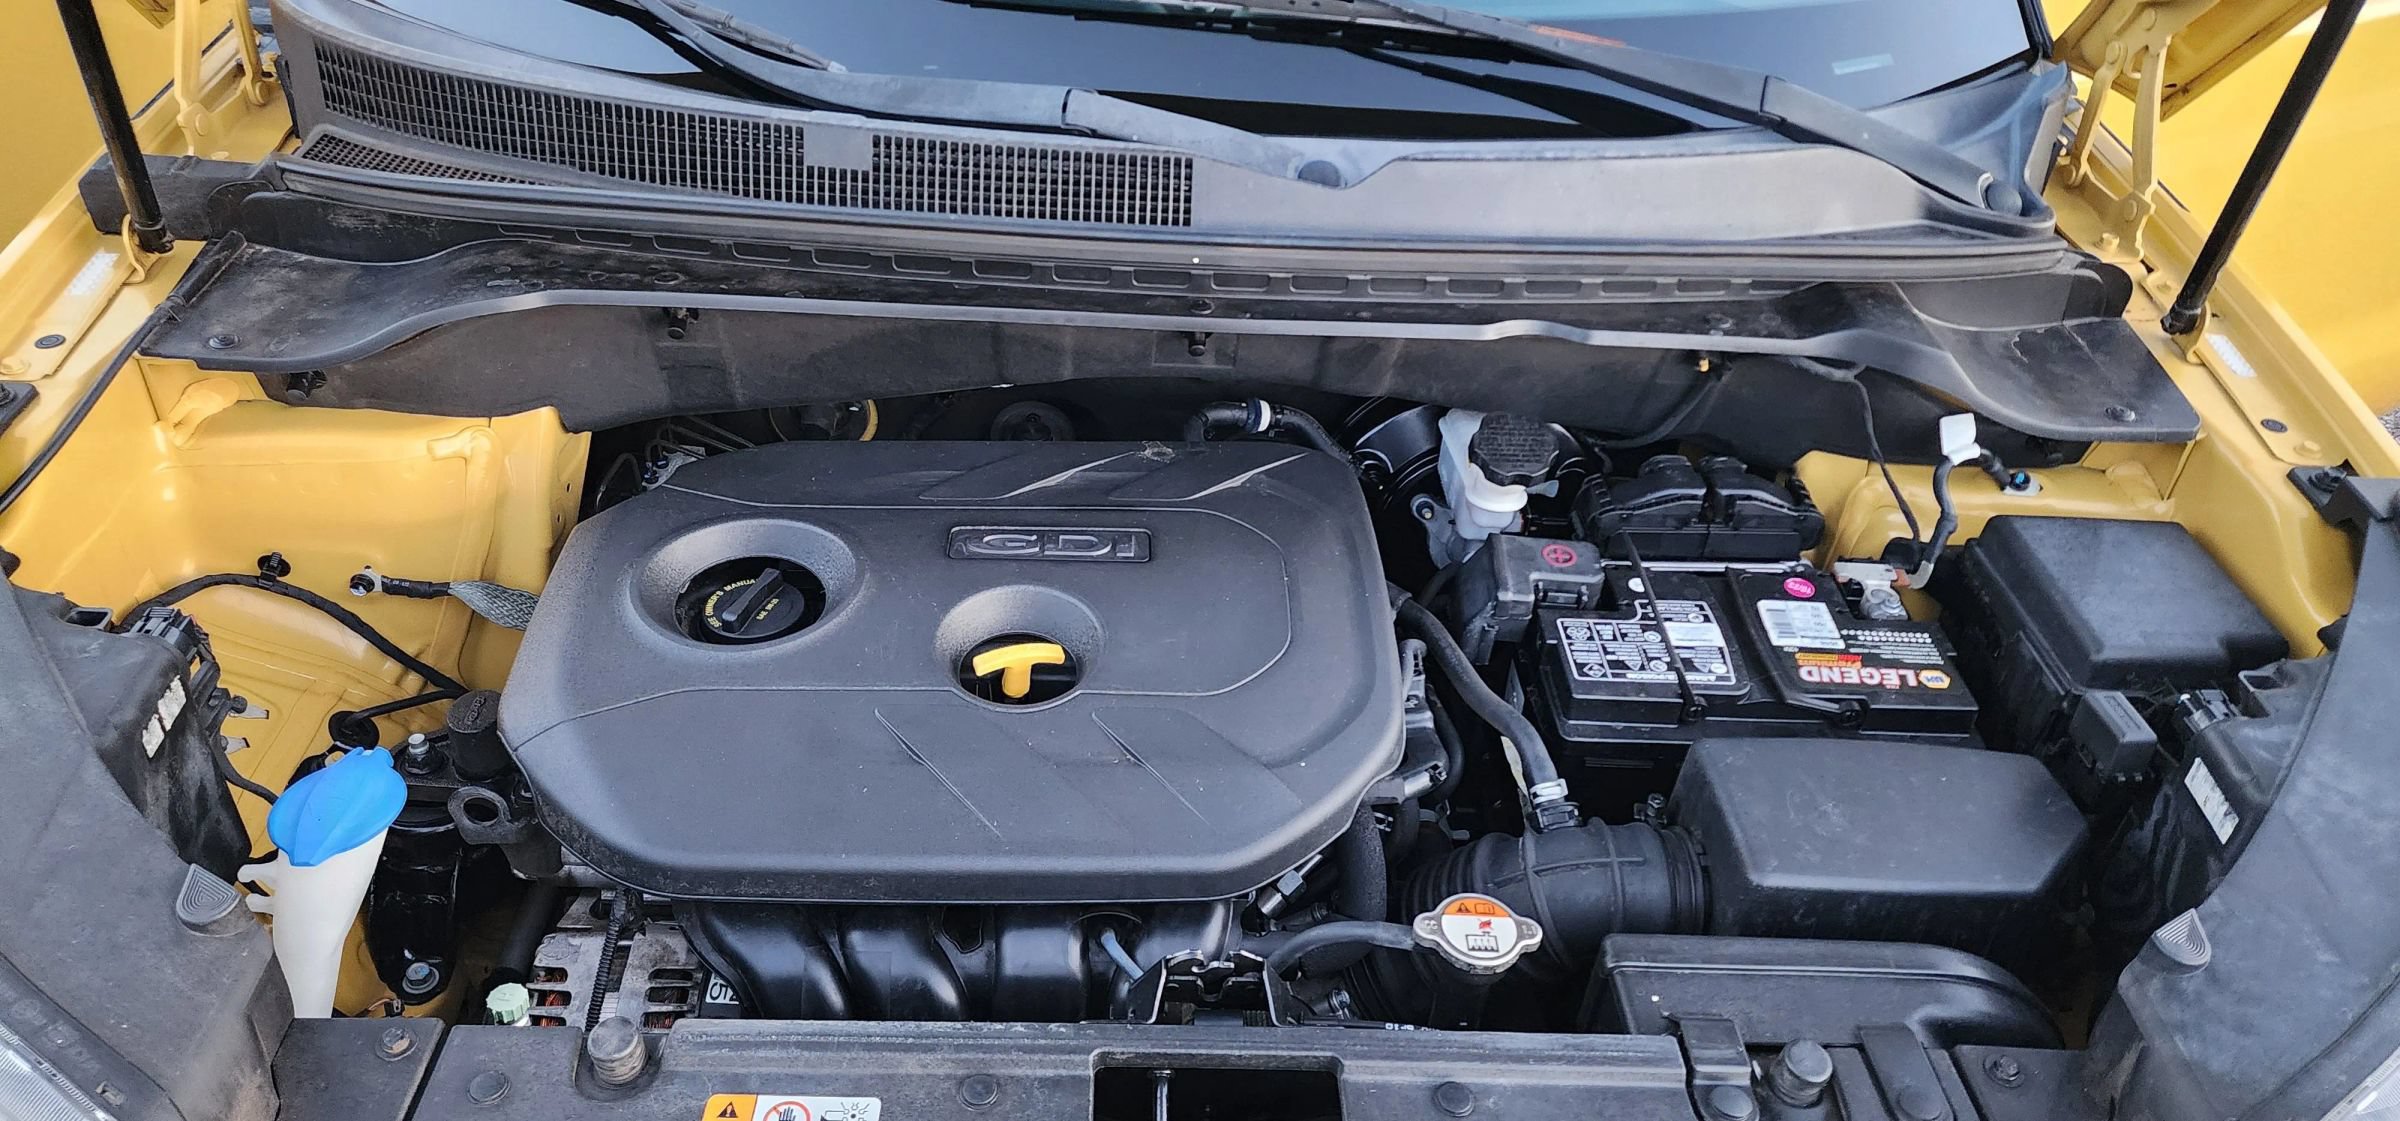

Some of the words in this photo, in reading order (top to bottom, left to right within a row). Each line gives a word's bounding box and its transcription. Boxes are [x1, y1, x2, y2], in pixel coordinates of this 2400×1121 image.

[967, 533, 1136, 557] GDI
[707, 616, 722, 628] SEE
[723, 578, 760, 592] MANUA
[1799, 665, 1919, 687] LEGEND
